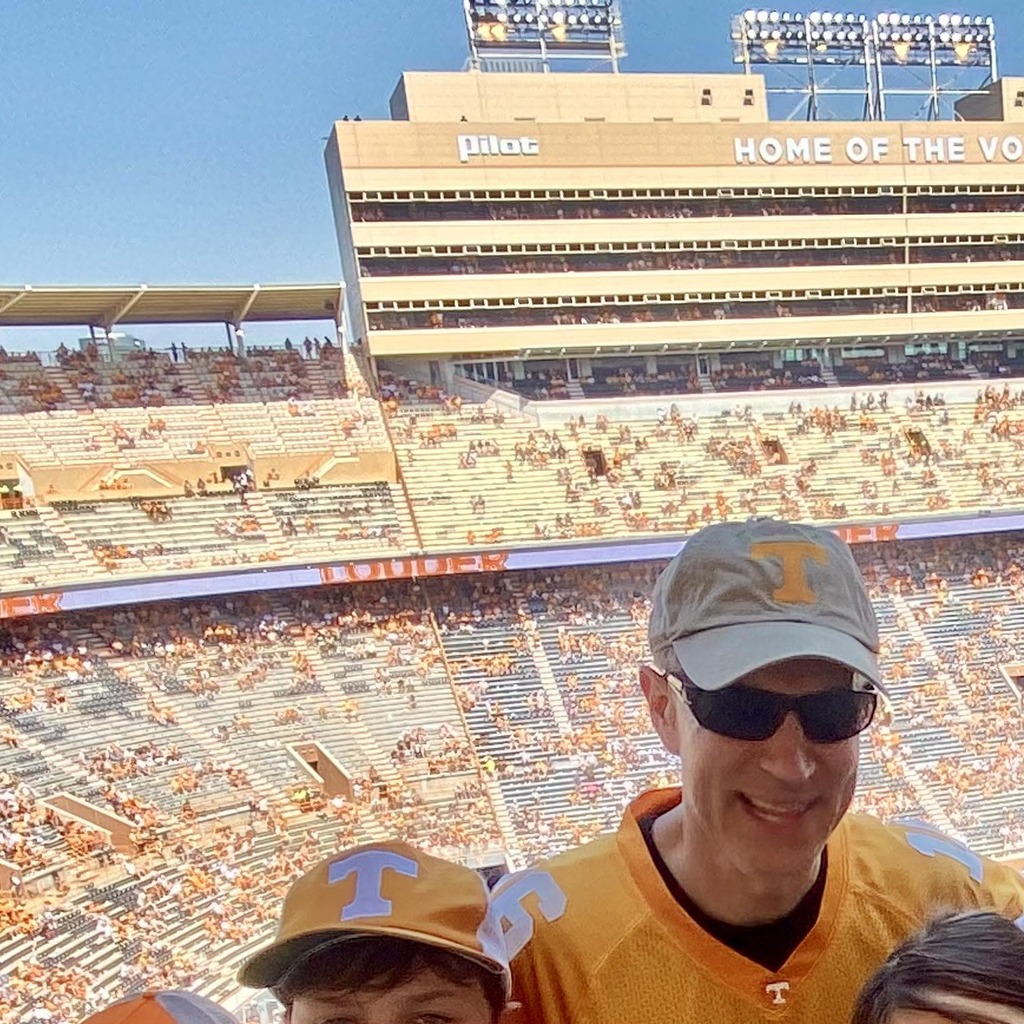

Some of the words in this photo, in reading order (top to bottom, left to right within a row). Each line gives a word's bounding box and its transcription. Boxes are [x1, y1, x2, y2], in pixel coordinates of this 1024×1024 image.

[734, 137, 832, 163] HOME
[845, 136, 888, 163] OF
[903, 136, 965, 162] THE
[832, 524, 899, 545] ER
[322, 552, 509, 585] LOUDER
[748, 541, 830, 606] T
[328, 850, 418, 921] T
[766, 982, 790, 1005] T
